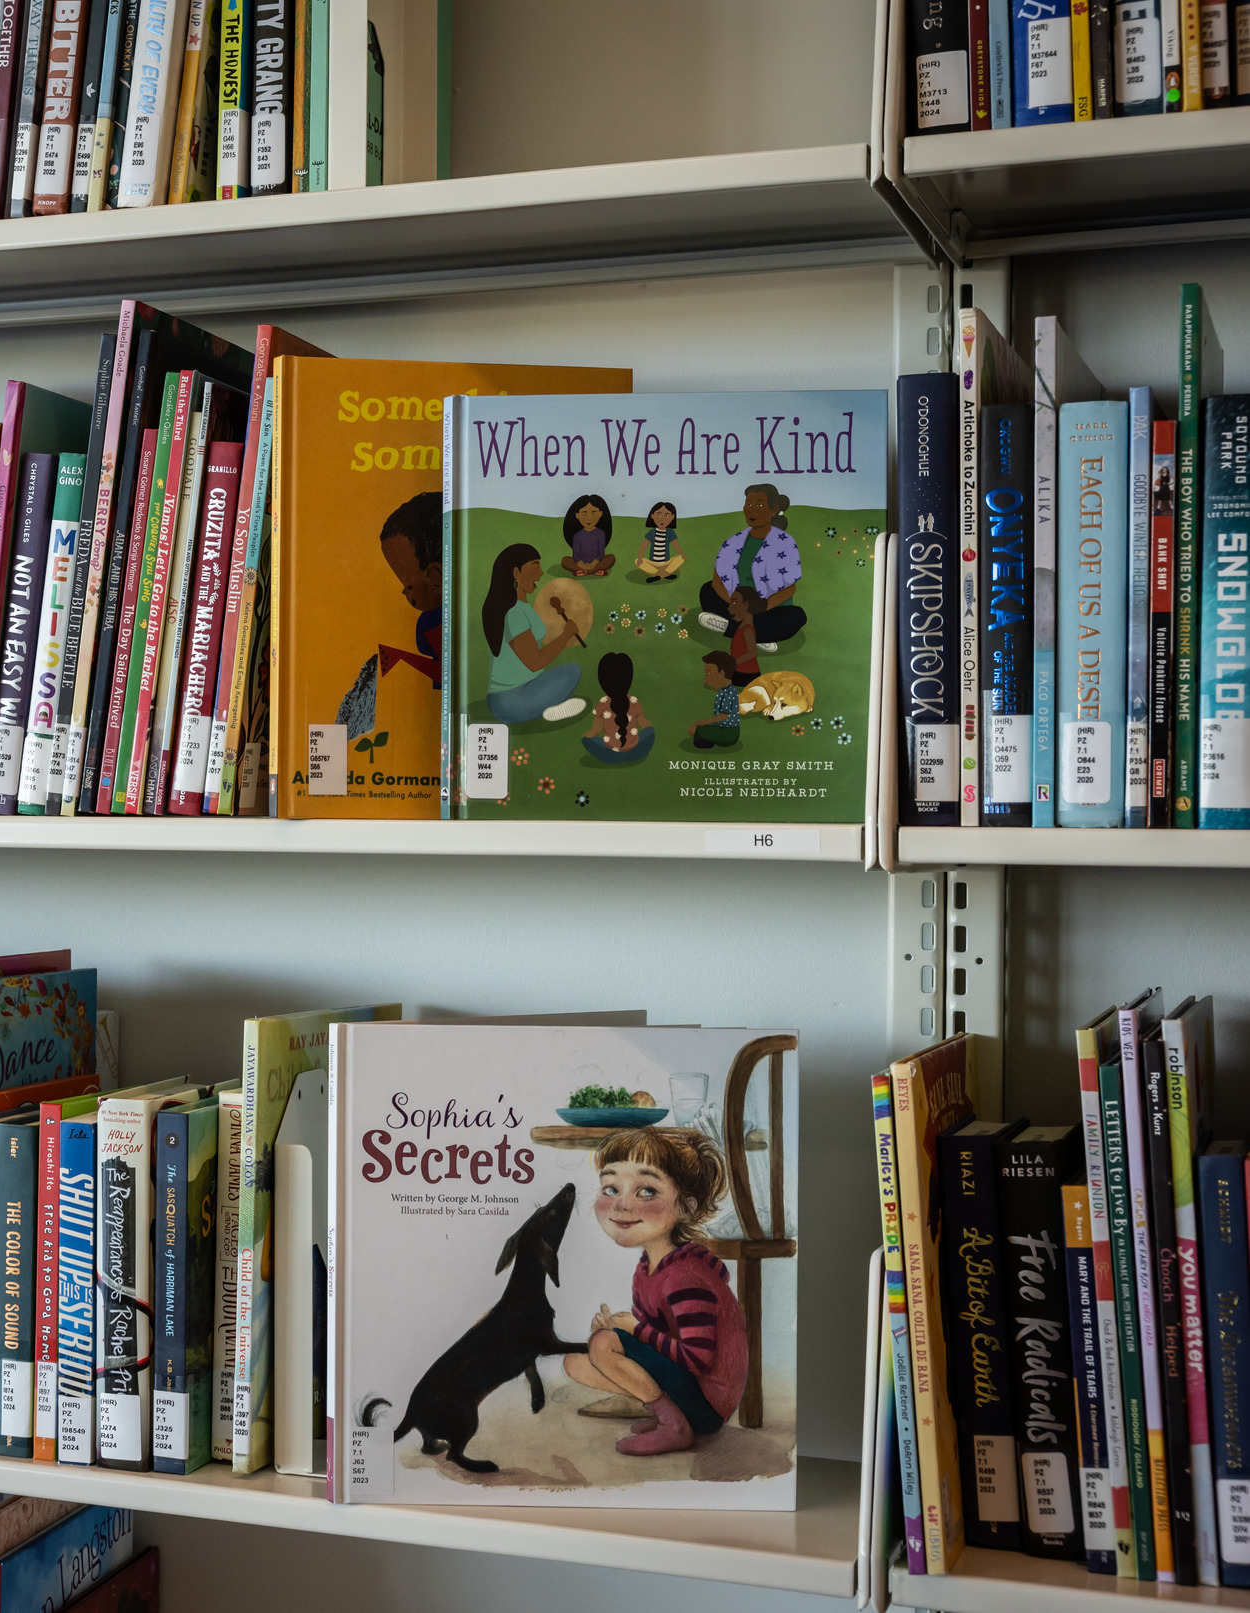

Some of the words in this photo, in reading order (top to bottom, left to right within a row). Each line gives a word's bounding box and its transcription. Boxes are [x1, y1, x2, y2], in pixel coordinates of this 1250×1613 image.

[224, 14, 240, 44] THE
[44, 0, 80, 121] BITTER
[918, 60, 941, 70] (HIR)
[221, 50, 240, 106] HONEST
[919, 89, 948, 98] M3713
[919, 99, 940, 107] T448
[920, 109, 940, 117] 2024
[1078, 96, 1087, 117] FSG
[964, 400, 975, 462] Artichoke
[473, 417, 589, 478] When
[601, 418, 660, 477] We
[675, 417, 740, 474] Are
[755, 412, 857, 474] Kind
[59, 476, 83, 486] GINO
[60, 466, 83, 476] ALEX
[207, 465, 237, 475] GRANILLO
[964, 465, 974, 478] to
[964, 481, 975, 536] Zucchini
[1038, 475, 1049, 526] ALIKA
[202, 488, 228, 561] CRUZITA
[238, 508, 252, 524] Yo
[233, 529, 248, 555] Soy
[1158, 538, 1168, 562] BANK
[985, 487, 1024, 634] ONYEKA
[12, 554, 34, 600] NOT
[227, 561, 245, 614] Muslim
[1157, 568, 1167, 590] SHOT
[9, 603, 31, 634] AN
[907, 542, 945, 718] SKIPSHOCK
[964, 626, 975, 656] Alice
[0, 639, 26, 690] EASY
[964, 660, 976, 692] Oehr
[478, 727, 494, 736] (HIR)
[668, 760, 737, 772] MONIQUE
[742, 760, 780, 770] GRAY
[786, 761, 834, 770] SMITH
[372, 771, 441, 786] Gorman
[704, 778, 779, 786] ILLUSTRATED
[783, 778, 797, 786] BY
[368, 790, 405, 799] Bestselling
[407, 791, 432, 799] Author
[680, 787, 734, 798] NICOLE
[739, 787, 828, 798] NEIDHARDT
[753, 833, 774, 847] H6
[1168, 1046, 1182, 1111] robinson
[386, 1092, 524, 1140] Sophia's
[107, 1130, 137, 1141] HOLLY
[101, 1142, 142, 1156] JACKSON
[361, 1129, 535, 1185] Secrets
[1010, 1154, 1044, 1165] LILA
[959, 1150, 975, 1198] RIAZI
[1001, 1165, 1056, 1178] RIESEN
[391, 1193, 423, 1203] Written
[425, 1193, 436, 1205] by
[438, 1194, 468, 1205] George
[470, 1195, 482, 1203] M.
[484, 1195, 519, 1204] Johnson
[7, 1200, 21, 1226] THE
[400, 1206, 443, 1216] Illustrated
[445, 1206, 456, 1218] by
[457, 1207, 475, 1216] Sara
[477, 1207, 510, 1216] Casilda
[6, 1230, 20, 1276] COLOR
[6, 1281, 19, 1300] OF
[5, 1305, 18, 1351] SOUND
[352, 1430, 370, 1438] (HIR)
[57, 1507, 133, 1601] Langston
